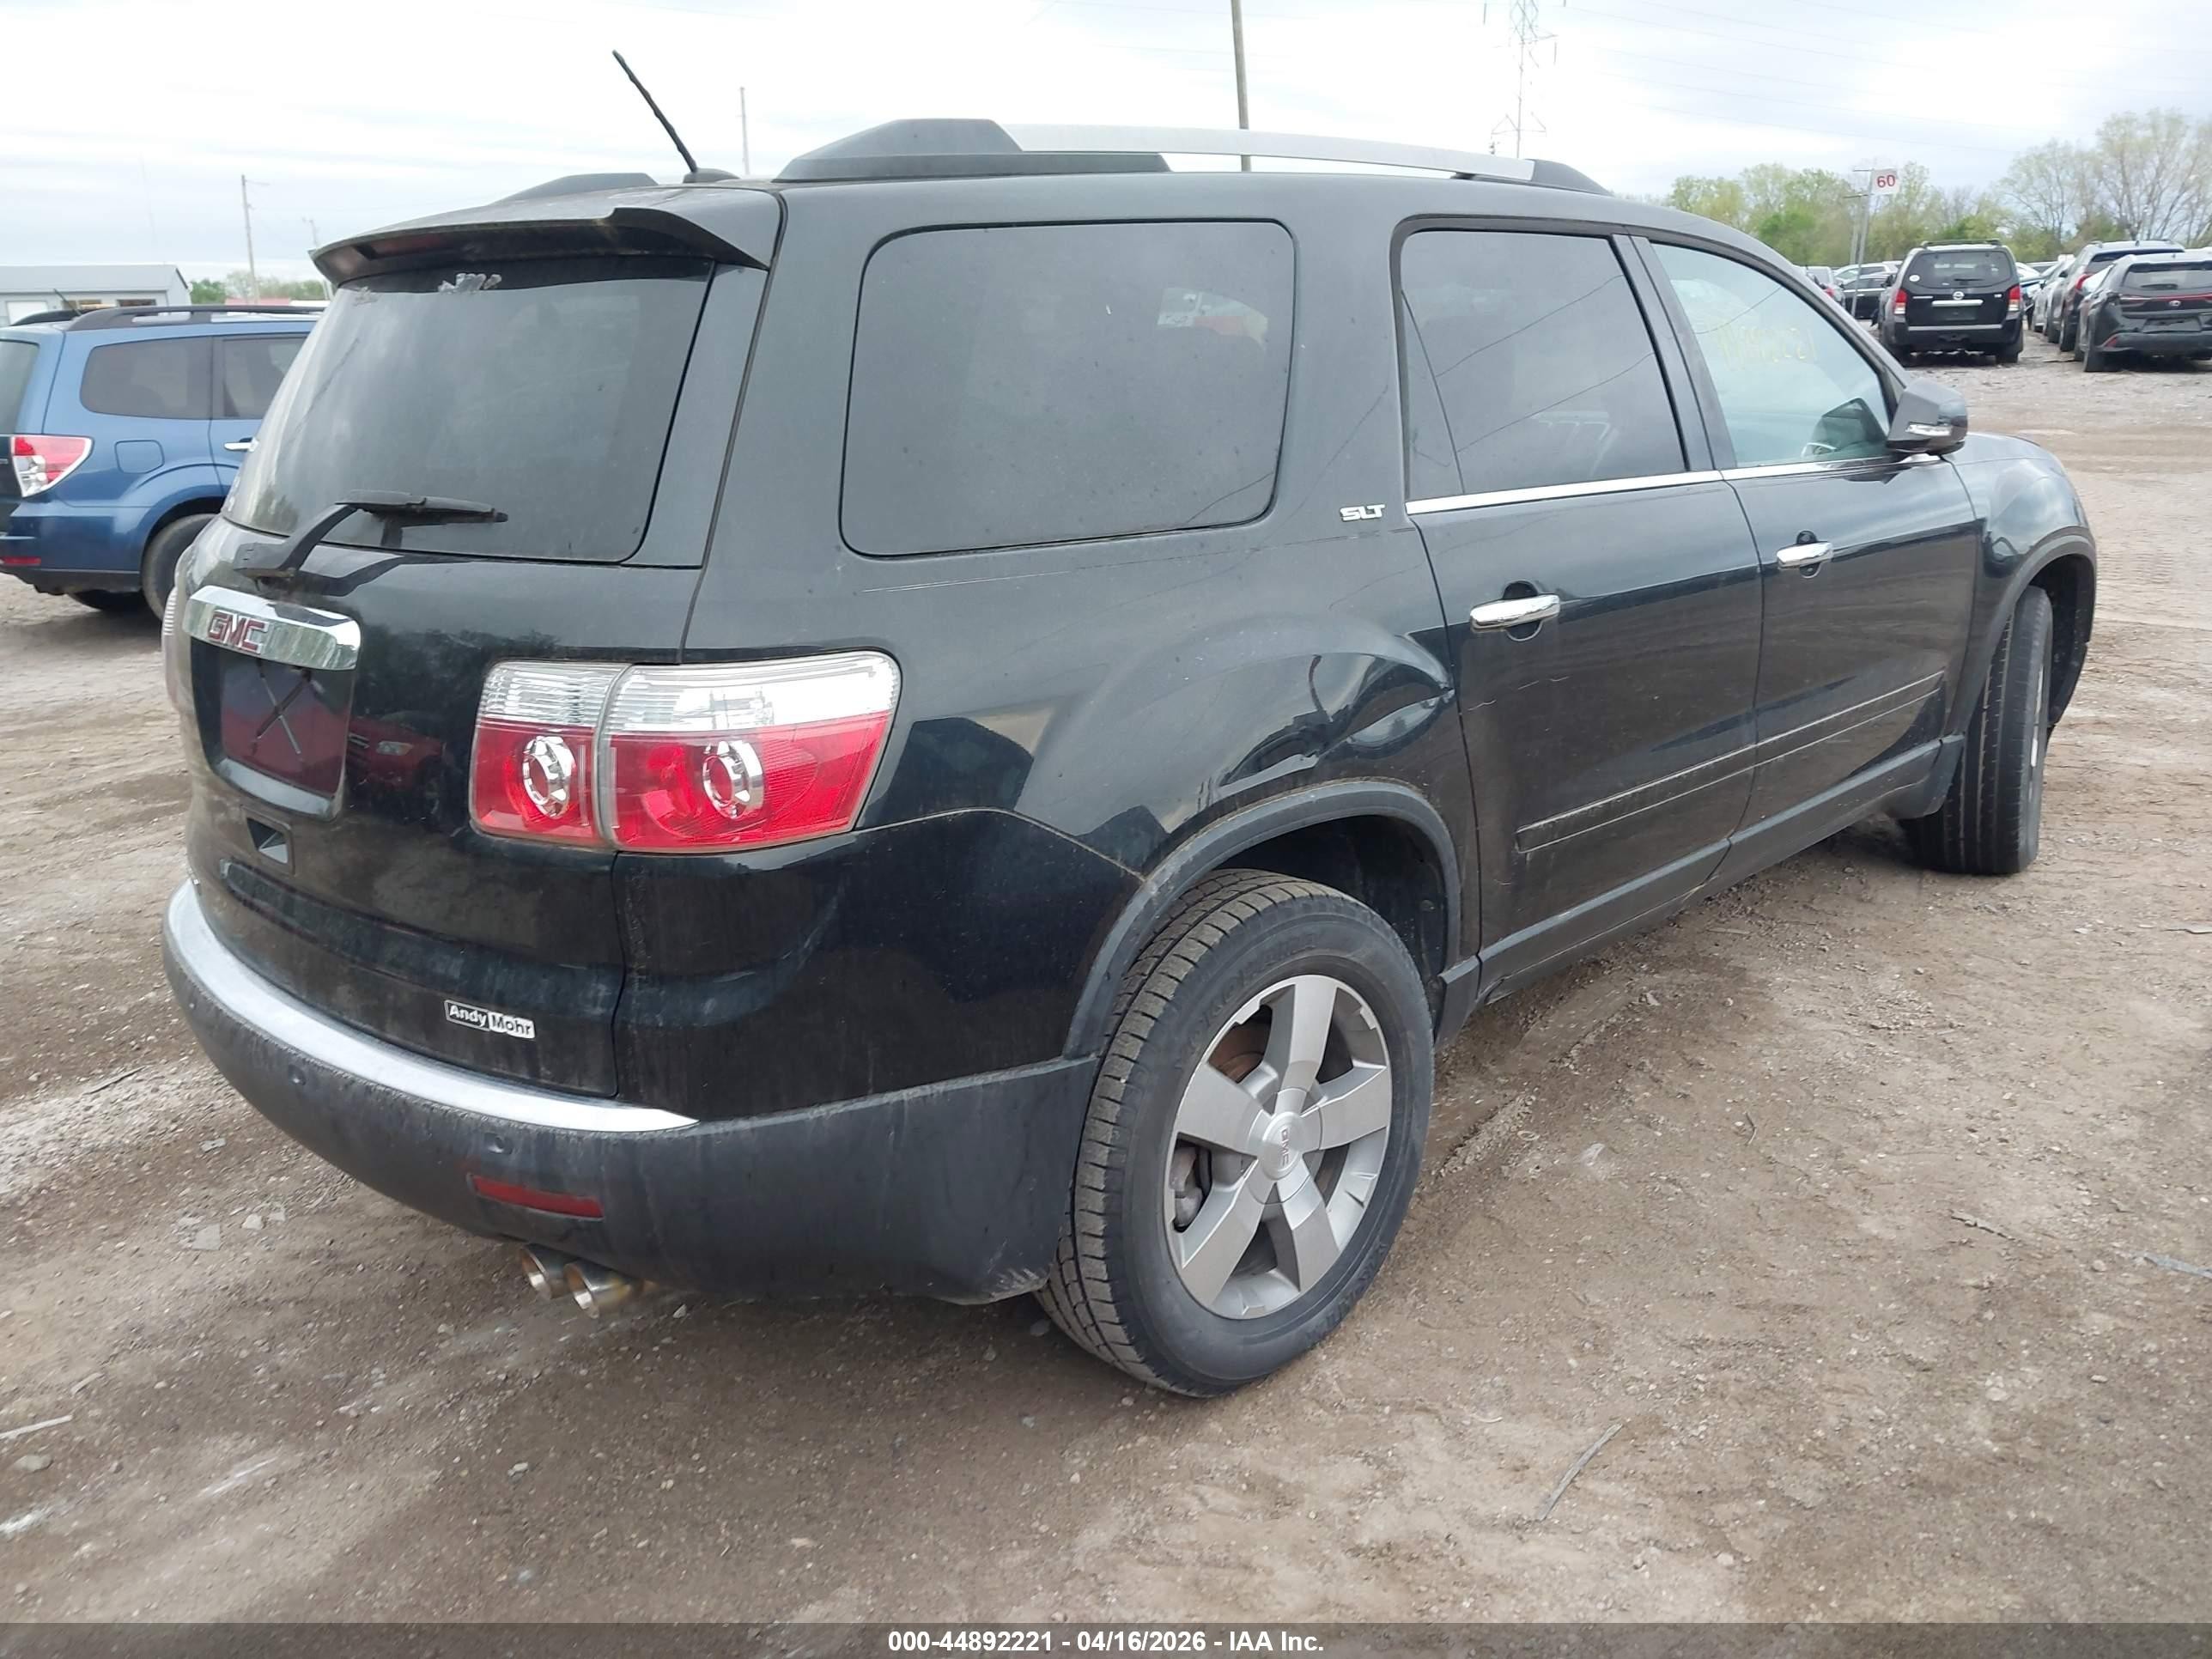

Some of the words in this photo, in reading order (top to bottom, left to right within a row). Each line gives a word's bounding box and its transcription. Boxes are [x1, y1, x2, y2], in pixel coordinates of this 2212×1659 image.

[1877, 174, 1896, 188] 60
[1340, 503, 1385, 522] SLT
[207, 609, 270, 655] GMC
[449, 1004, 488, 1028] Andy
[491, 1013, 532, 1036] Mohr
[1279, 1126, 1290, 1168] GMC
